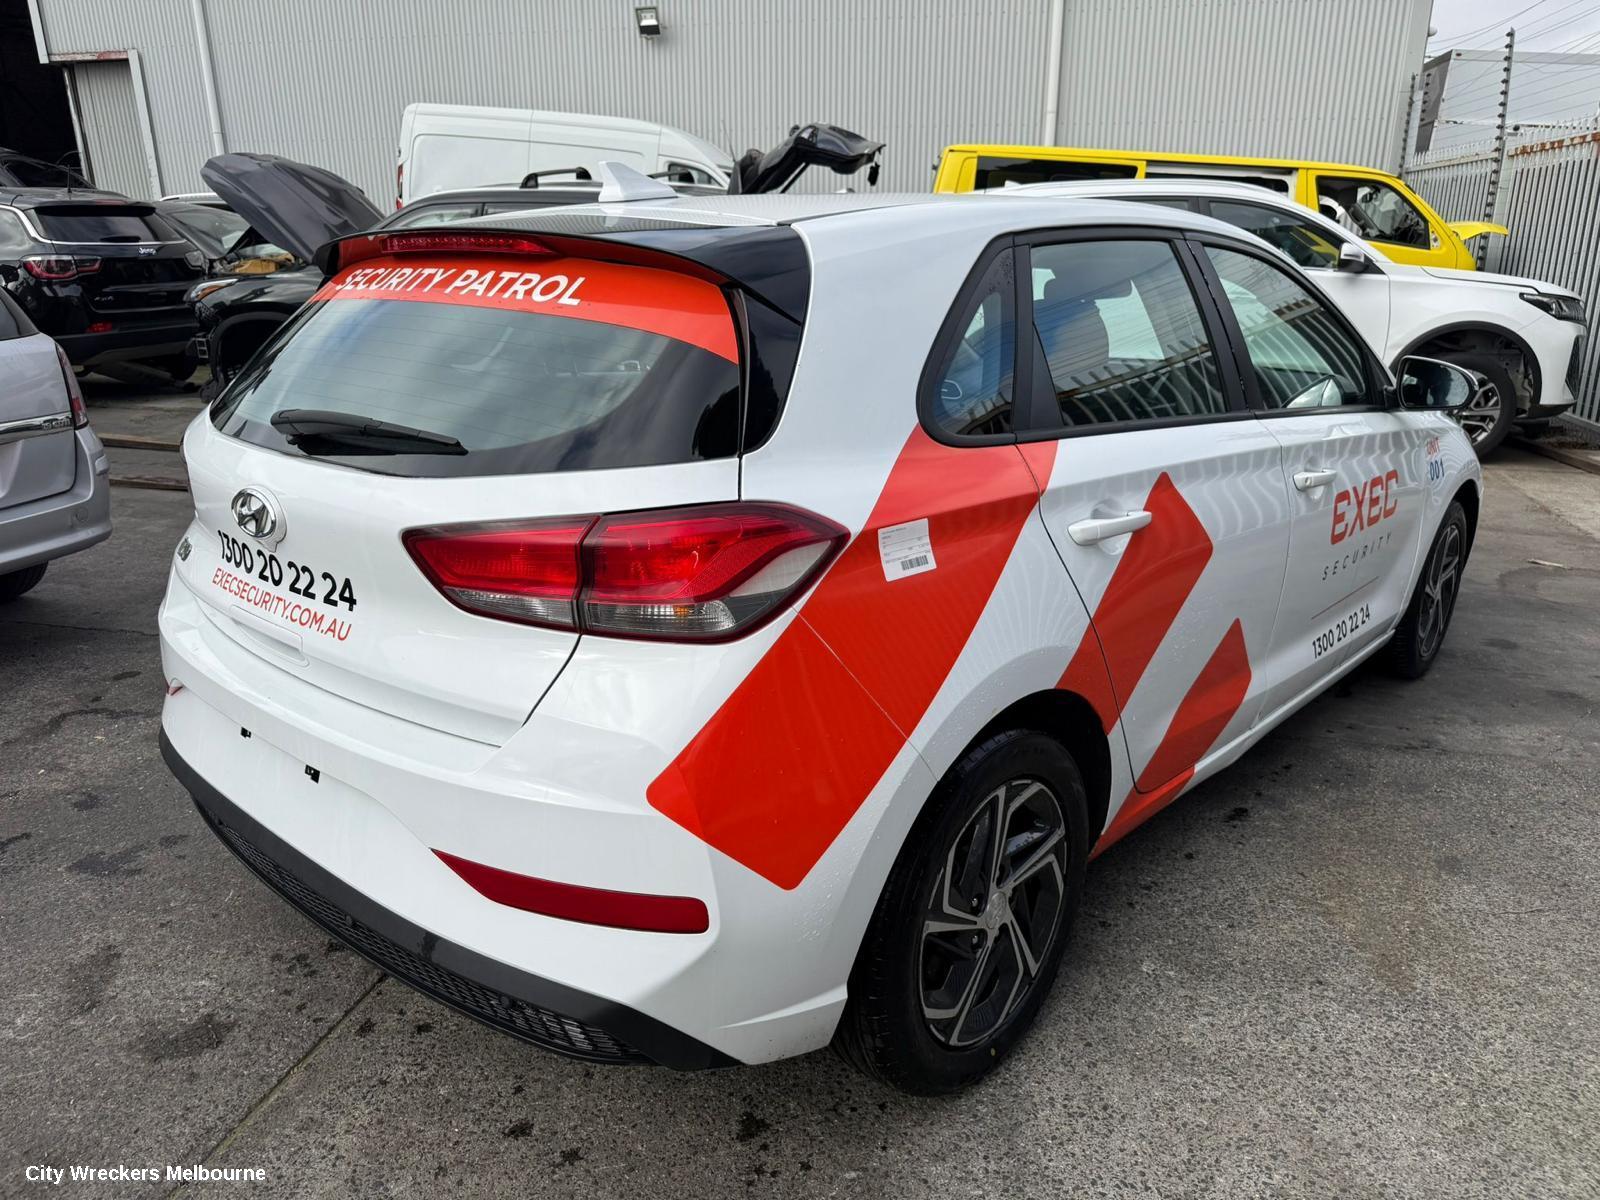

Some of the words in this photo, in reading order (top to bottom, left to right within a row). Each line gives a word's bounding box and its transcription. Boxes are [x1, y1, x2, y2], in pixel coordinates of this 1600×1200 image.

[335, 267, 456, 293] SECURITY
[443, 269, 587, 306] PATROL
[1429, 457, 1445, 481] 001
[1330, 469, 1399, 545] EXEC
[217, 529, 255, 574] 1300
[256, 549, 284, 587] 20
[287, 560, 317, 601] 22
[321, 571, 358, 612] 24
[1321, 532, 1392, 581] SECURITY
[212, 567, 352, 641] EXECSECURITY.COM.AU
[1312, 629, 1336, 659] 1300
[1335, 621, 1348, 643] 20
[1348, 613, 1360, 635] 22
[1359, 602, 1371, 626] 24
